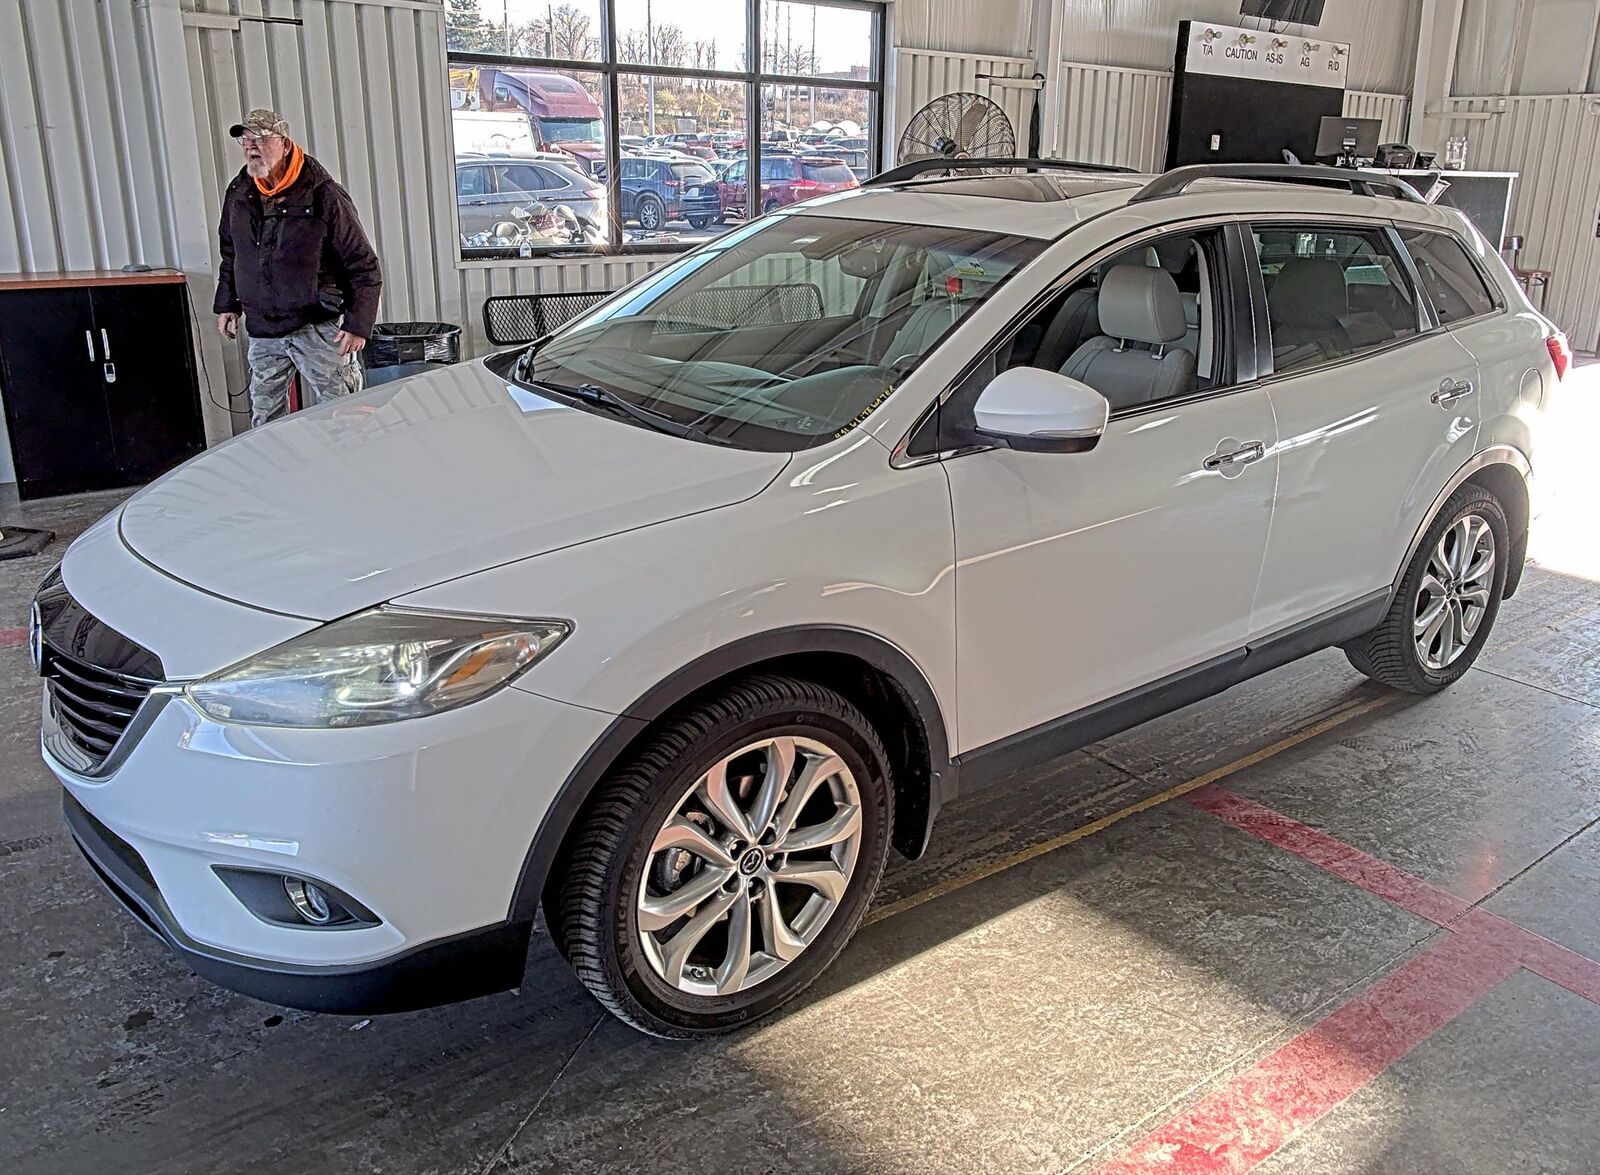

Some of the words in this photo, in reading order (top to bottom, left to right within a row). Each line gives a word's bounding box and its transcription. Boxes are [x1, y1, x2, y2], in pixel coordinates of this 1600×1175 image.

[1202, 44, 1214, 55] T/A
[1225, 47, 1258, 61] CAUTION
[1265, 53, 1284, 65] AS-IS
[1299, 57, 1310, 68] AG
